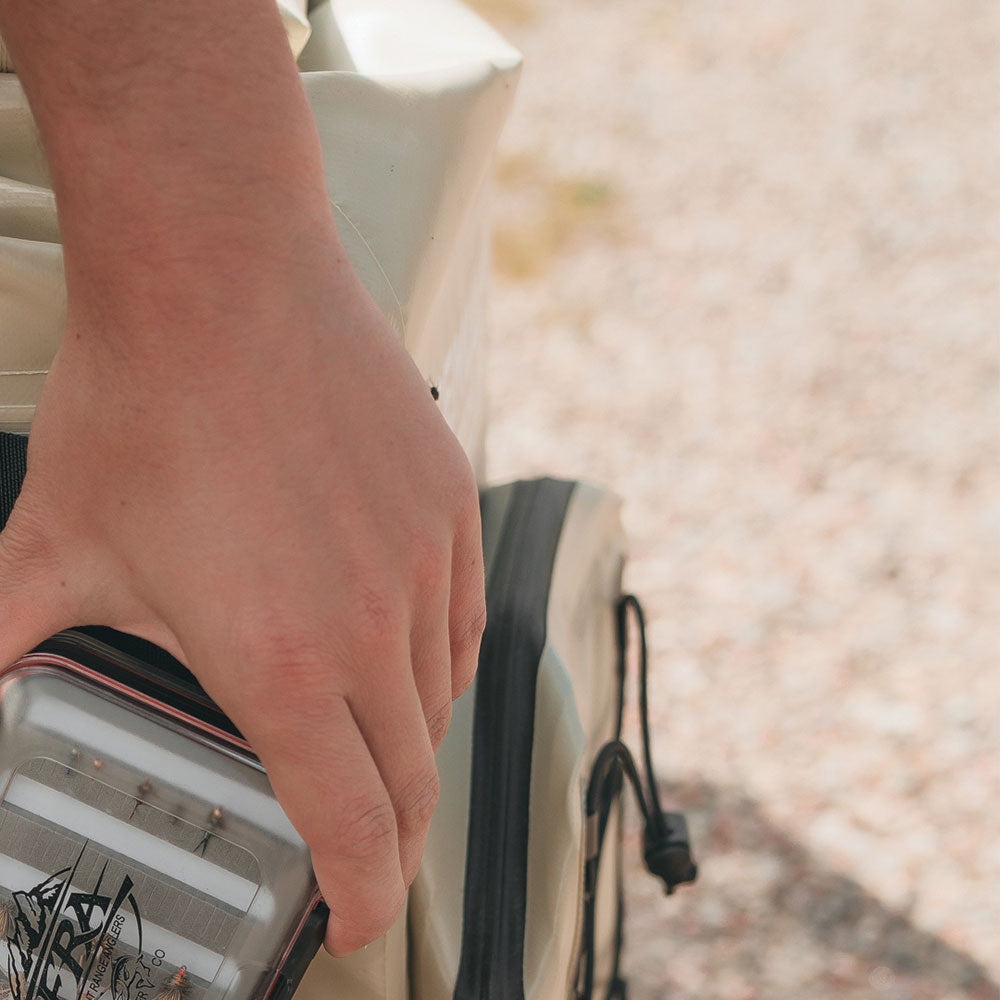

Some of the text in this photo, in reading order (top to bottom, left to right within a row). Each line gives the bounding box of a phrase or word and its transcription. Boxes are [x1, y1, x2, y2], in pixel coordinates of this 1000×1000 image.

[89, 960, 108, 993] RANGE
[104, 914, 126, 964] ANGLERS
[151, 949, 166, 967] CO
